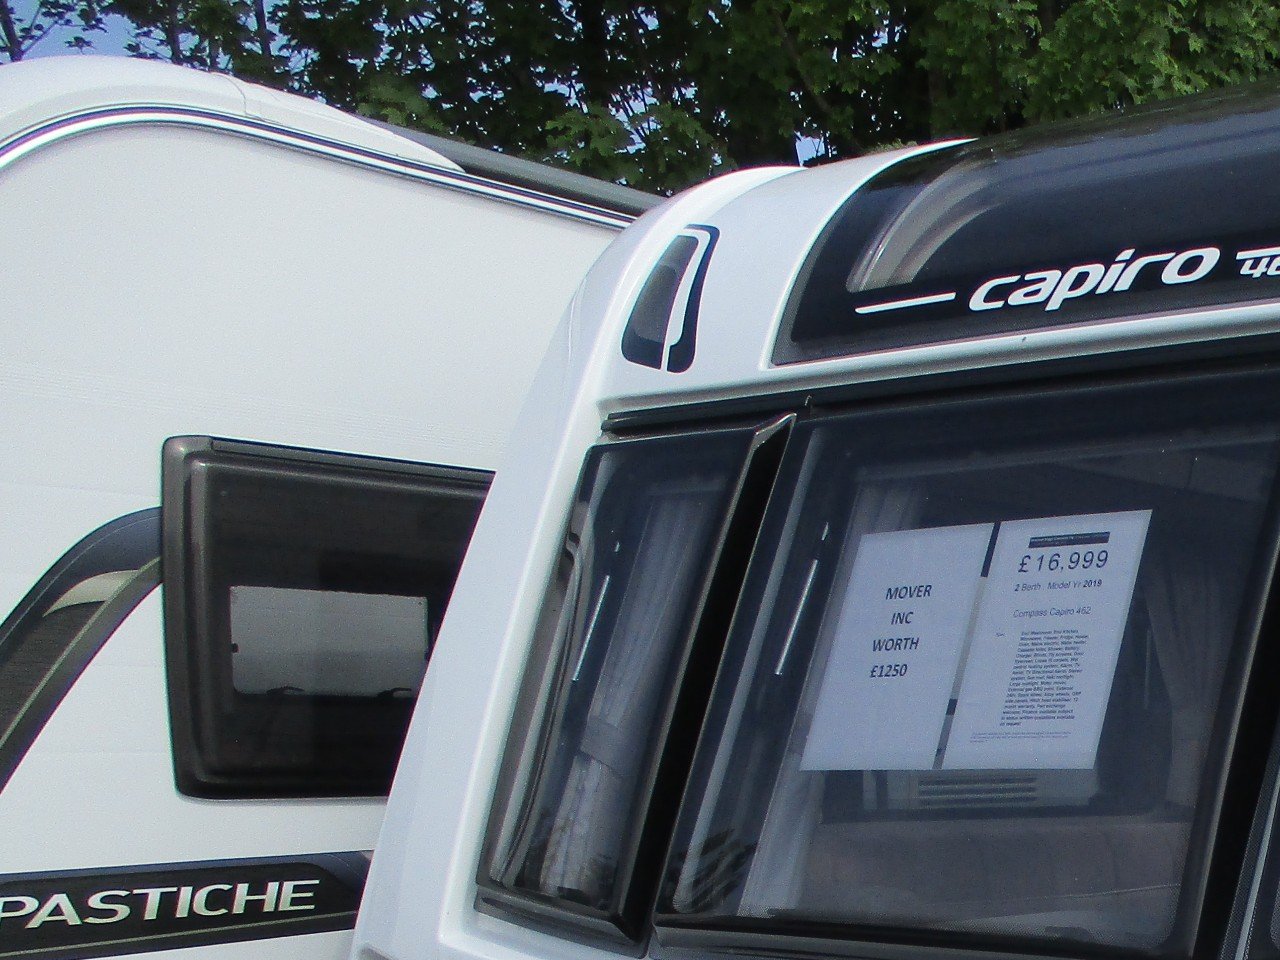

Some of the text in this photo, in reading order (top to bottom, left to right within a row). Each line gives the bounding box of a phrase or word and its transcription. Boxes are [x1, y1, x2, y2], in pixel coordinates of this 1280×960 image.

[968, 247, 1221, 311] capiro
[1018, 549, 1110, 573] £16,999
[1047, 581, 1071, 590] Model
[1083, 578, 1103, 588] 2019
[885, 584, 933, 600] MOVER
[890, 611, 914, 625] INC
[1012, 605, 1092, 618] Compass Capiro 462
[872, 637, 920, 652] WORTH
[869, 663, 908, 678] £1250
[0, 879, 320, 929] PASTICHE
